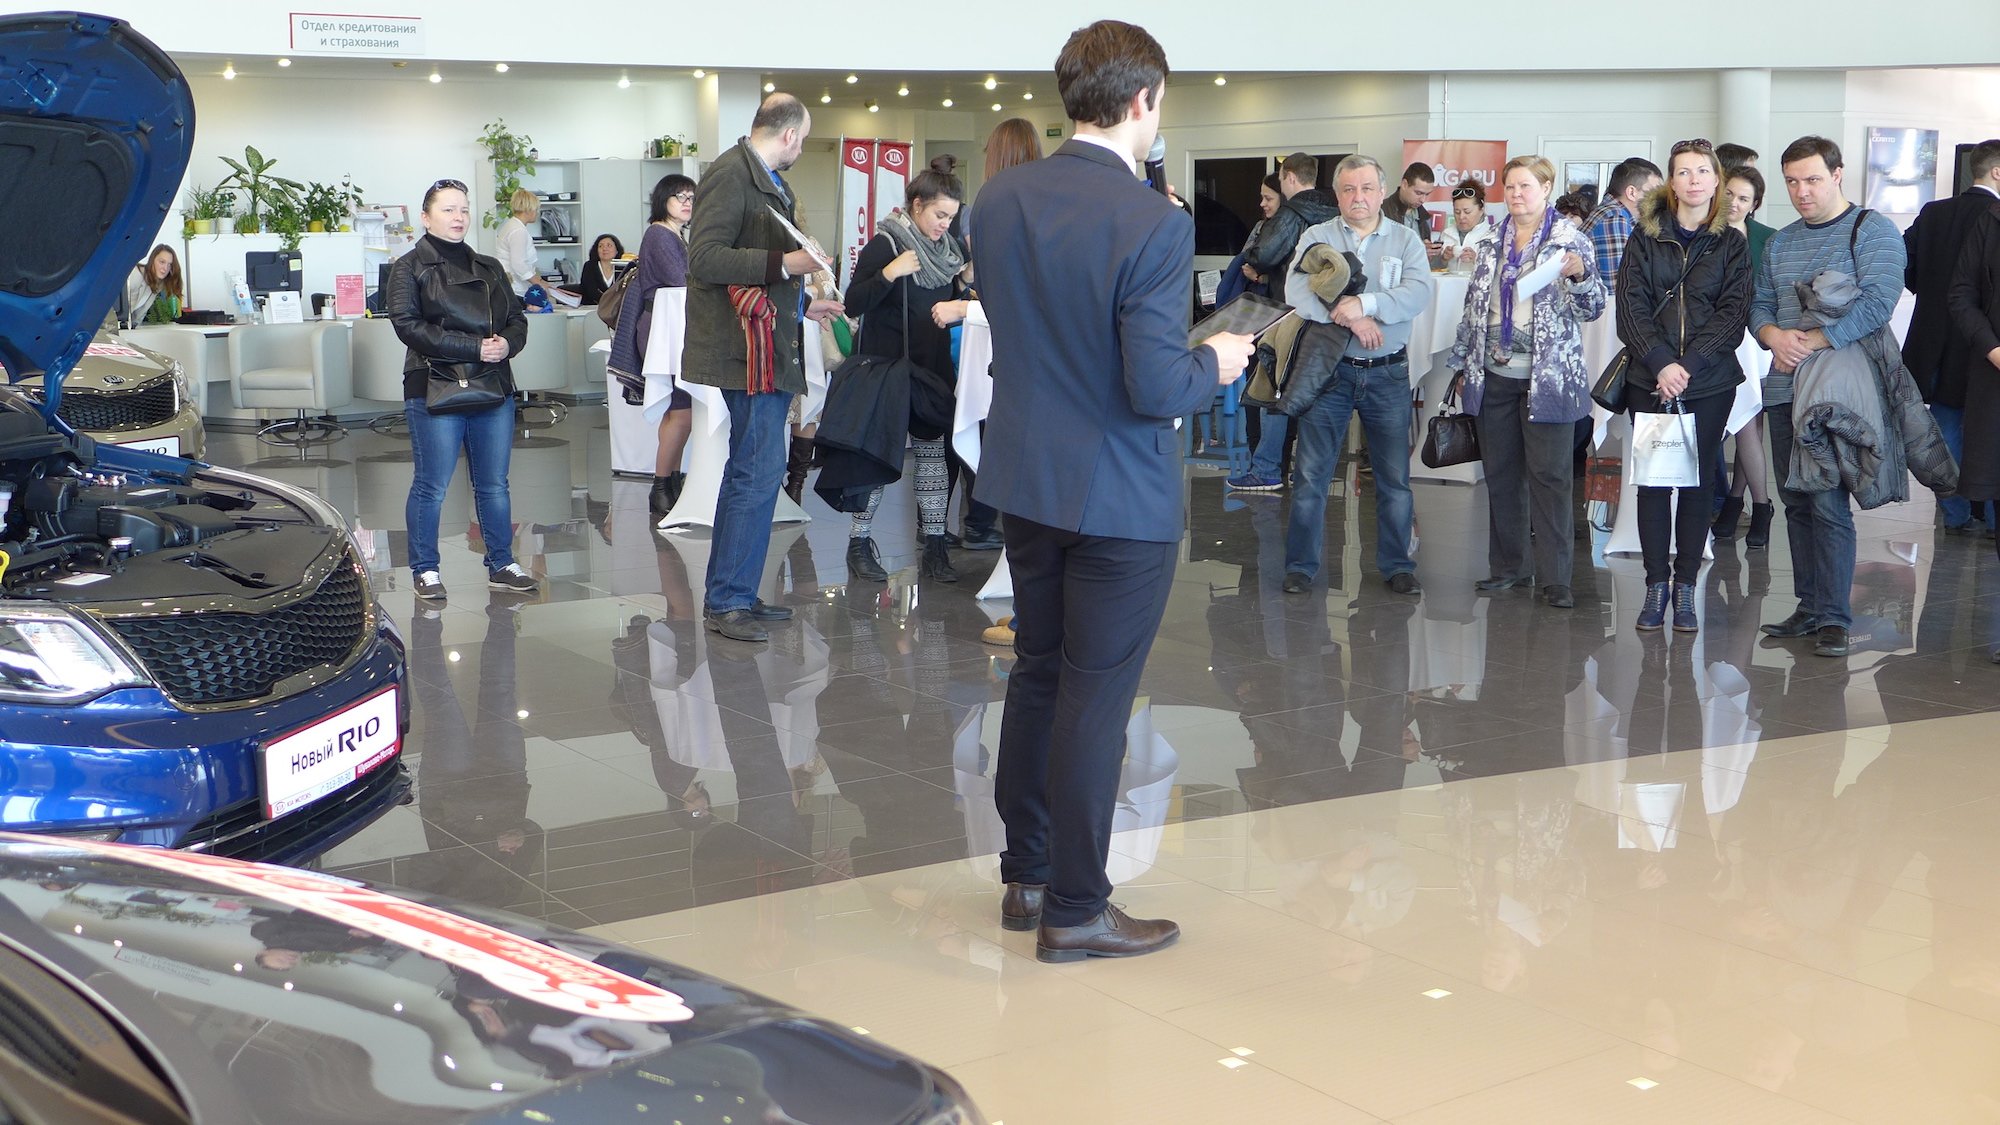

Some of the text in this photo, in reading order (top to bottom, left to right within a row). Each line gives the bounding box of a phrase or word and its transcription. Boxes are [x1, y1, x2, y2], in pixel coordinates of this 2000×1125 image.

[301, 19, 417, 34] Отдел кредитования
[320, 37, 399, 48] и страхования
[290, 716, 380, 775] Новый RIO
